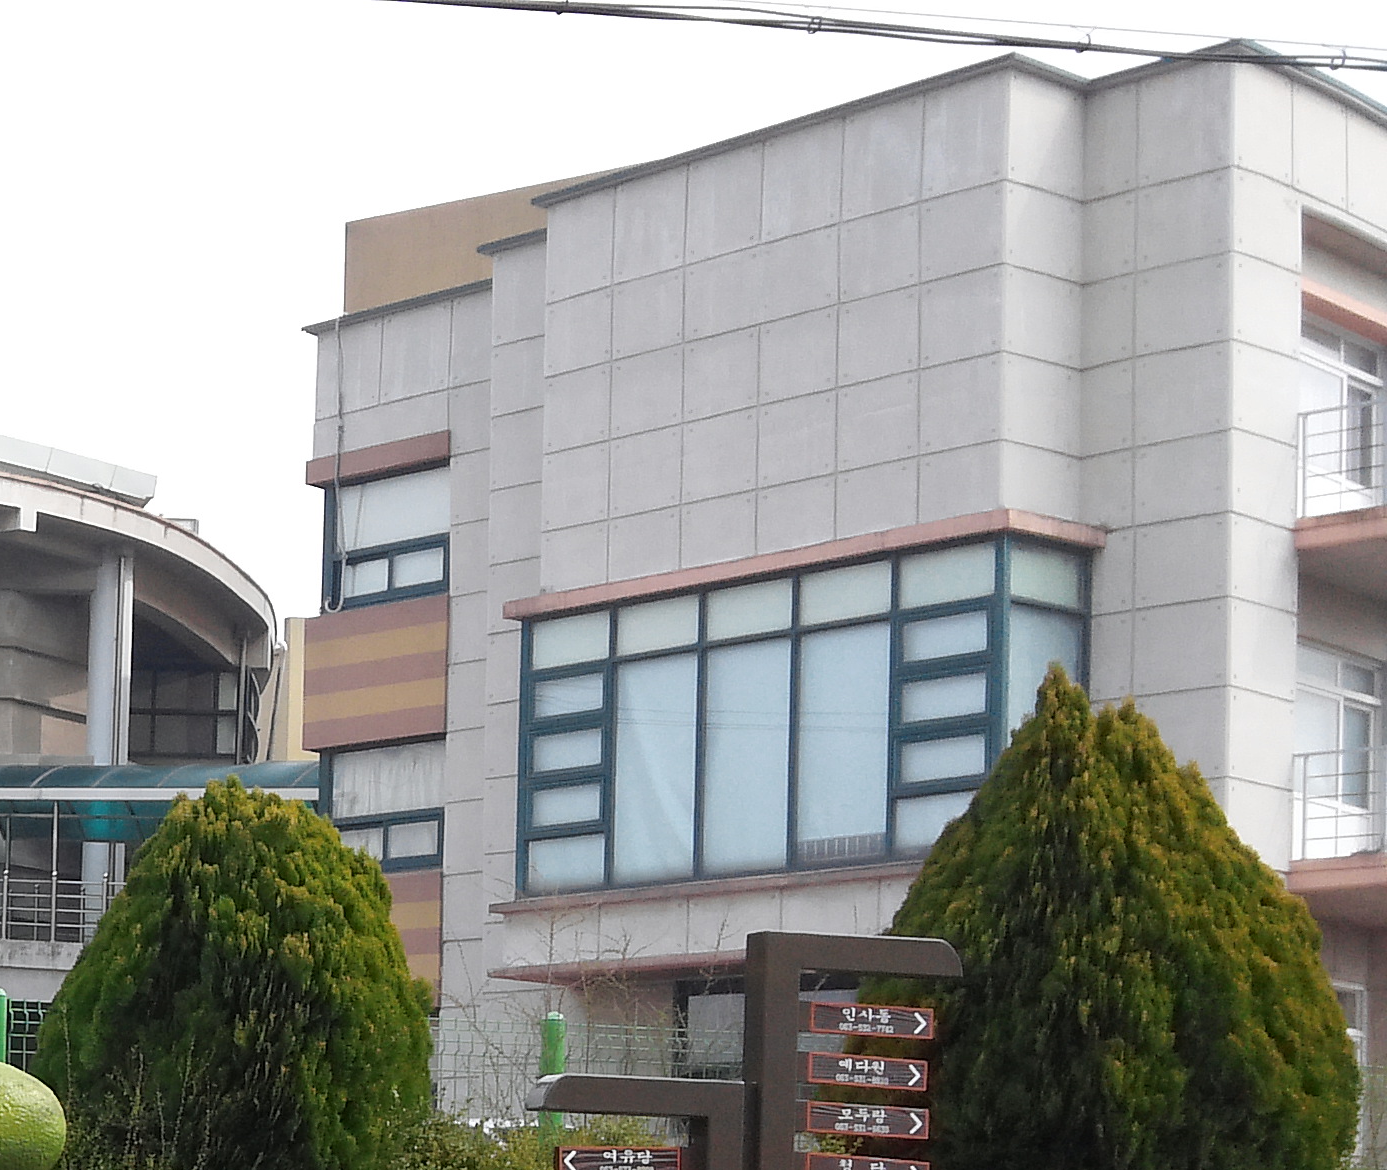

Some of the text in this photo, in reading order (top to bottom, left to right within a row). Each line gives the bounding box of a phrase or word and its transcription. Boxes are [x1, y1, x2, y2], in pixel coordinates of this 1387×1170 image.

[841, 1007, 891, 1023] 인사동
[838, 1059, 885, 1075] 예다원
[838, 1108, 887, 1124] 모두랑
[602, 1149, 653, 1164] 여유당
